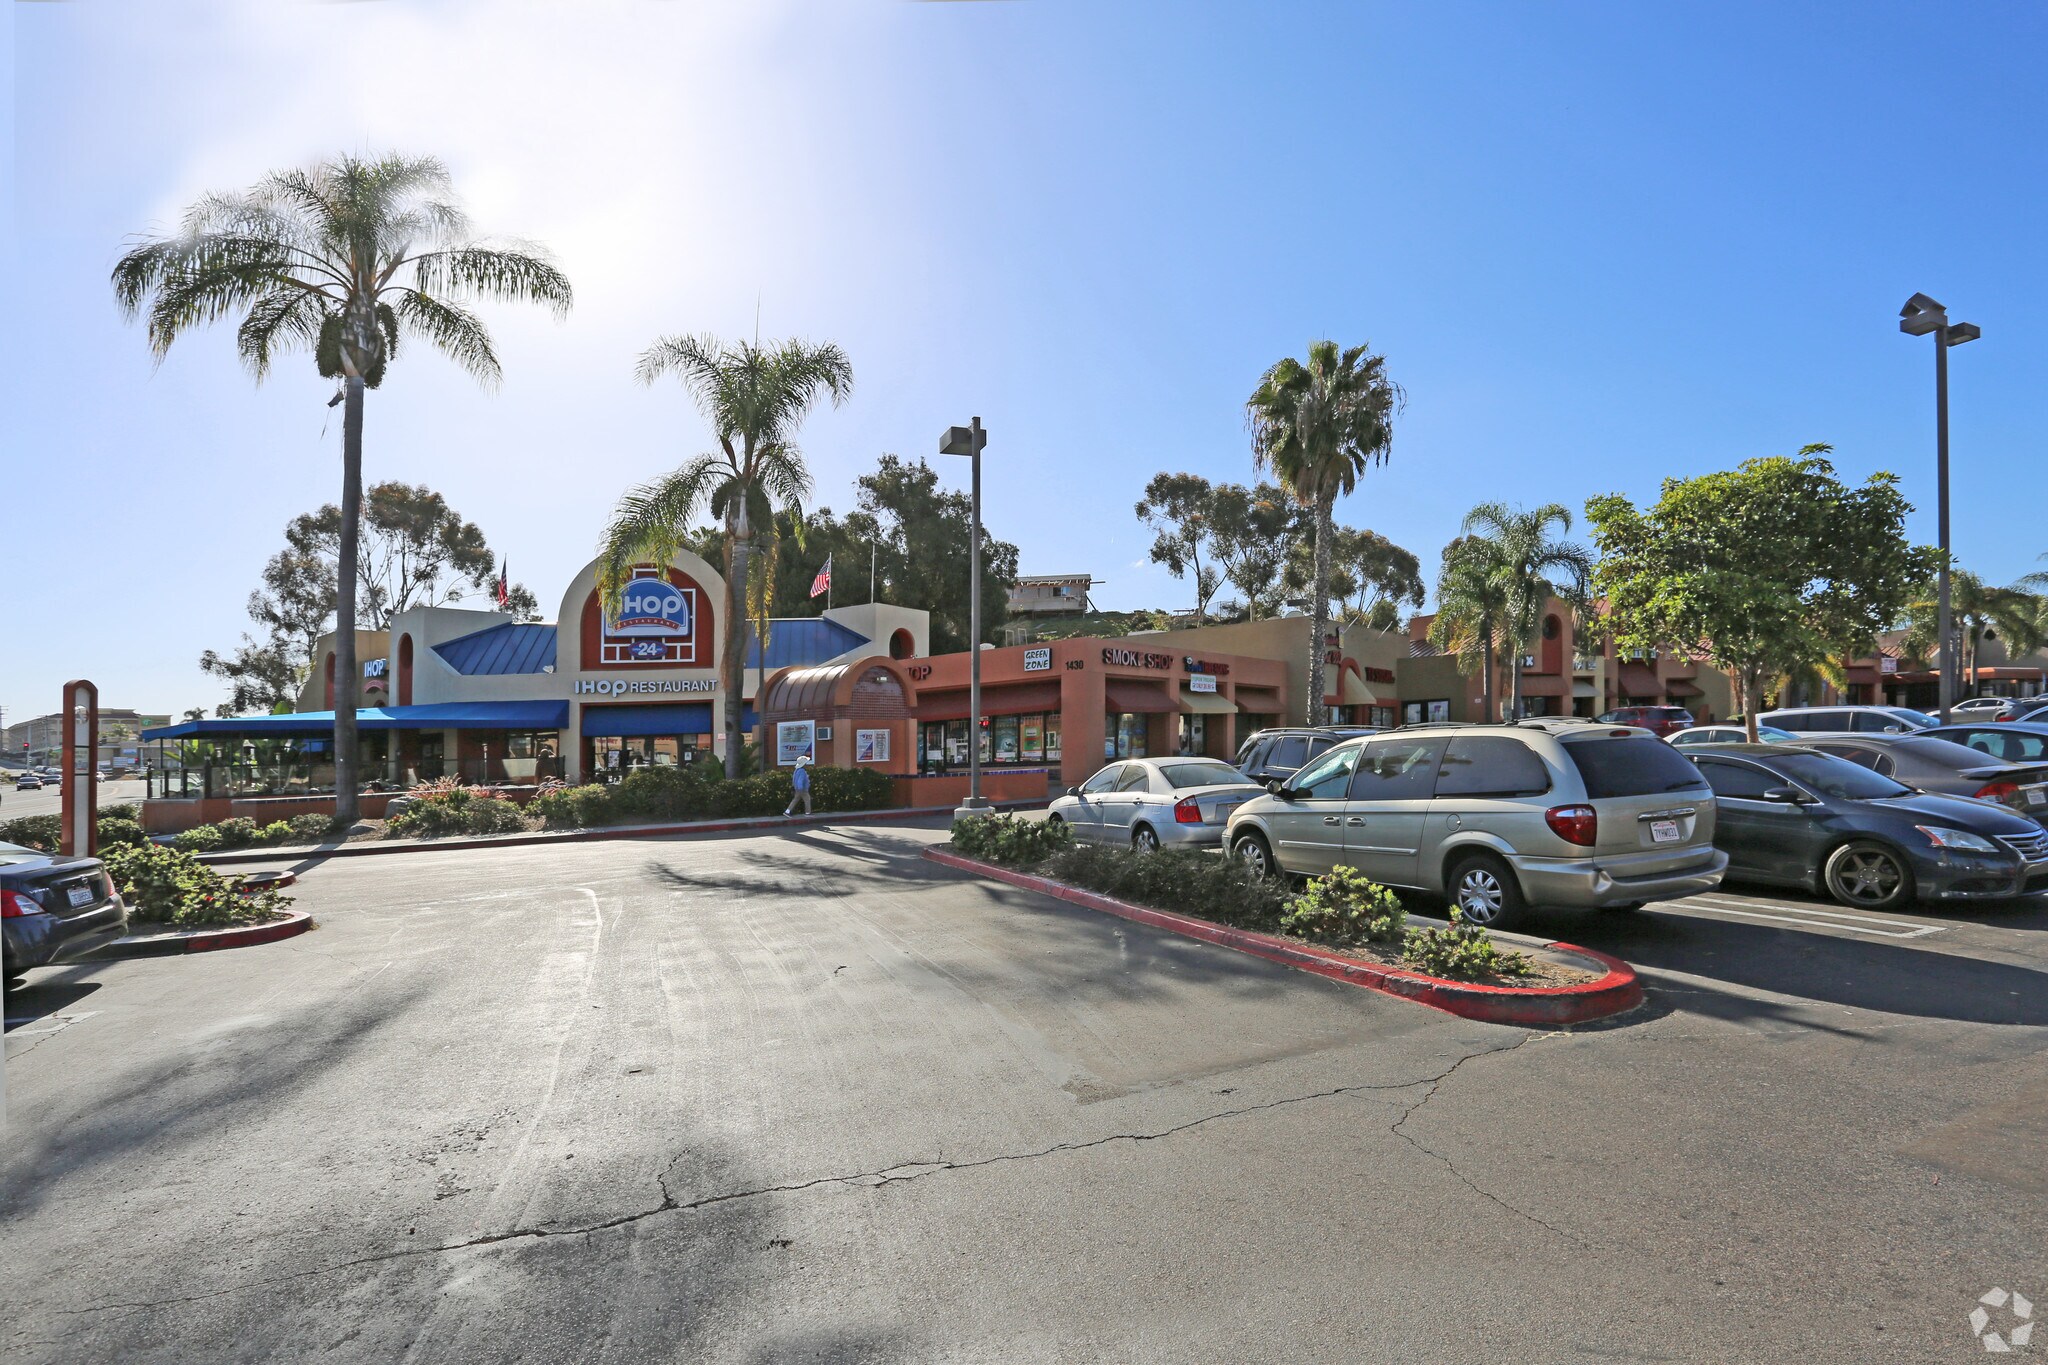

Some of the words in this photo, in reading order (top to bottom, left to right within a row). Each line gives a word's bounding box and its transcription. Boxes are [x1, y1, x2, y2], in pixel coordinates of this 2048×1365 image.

[616, 618, 677, 628] ESTAURANT
[638, 642, 658, 656] 24
[1026, 650, 1048, 659] GREEN
[364, 659, 385, 677] IHOP
[1026, 660, 1048, 669] ZONE
[1065, 660, 1084, 670] 1430
[574, 679, 628, 697] IHOP
[630, 680, 718, 693] RESTAURANT
